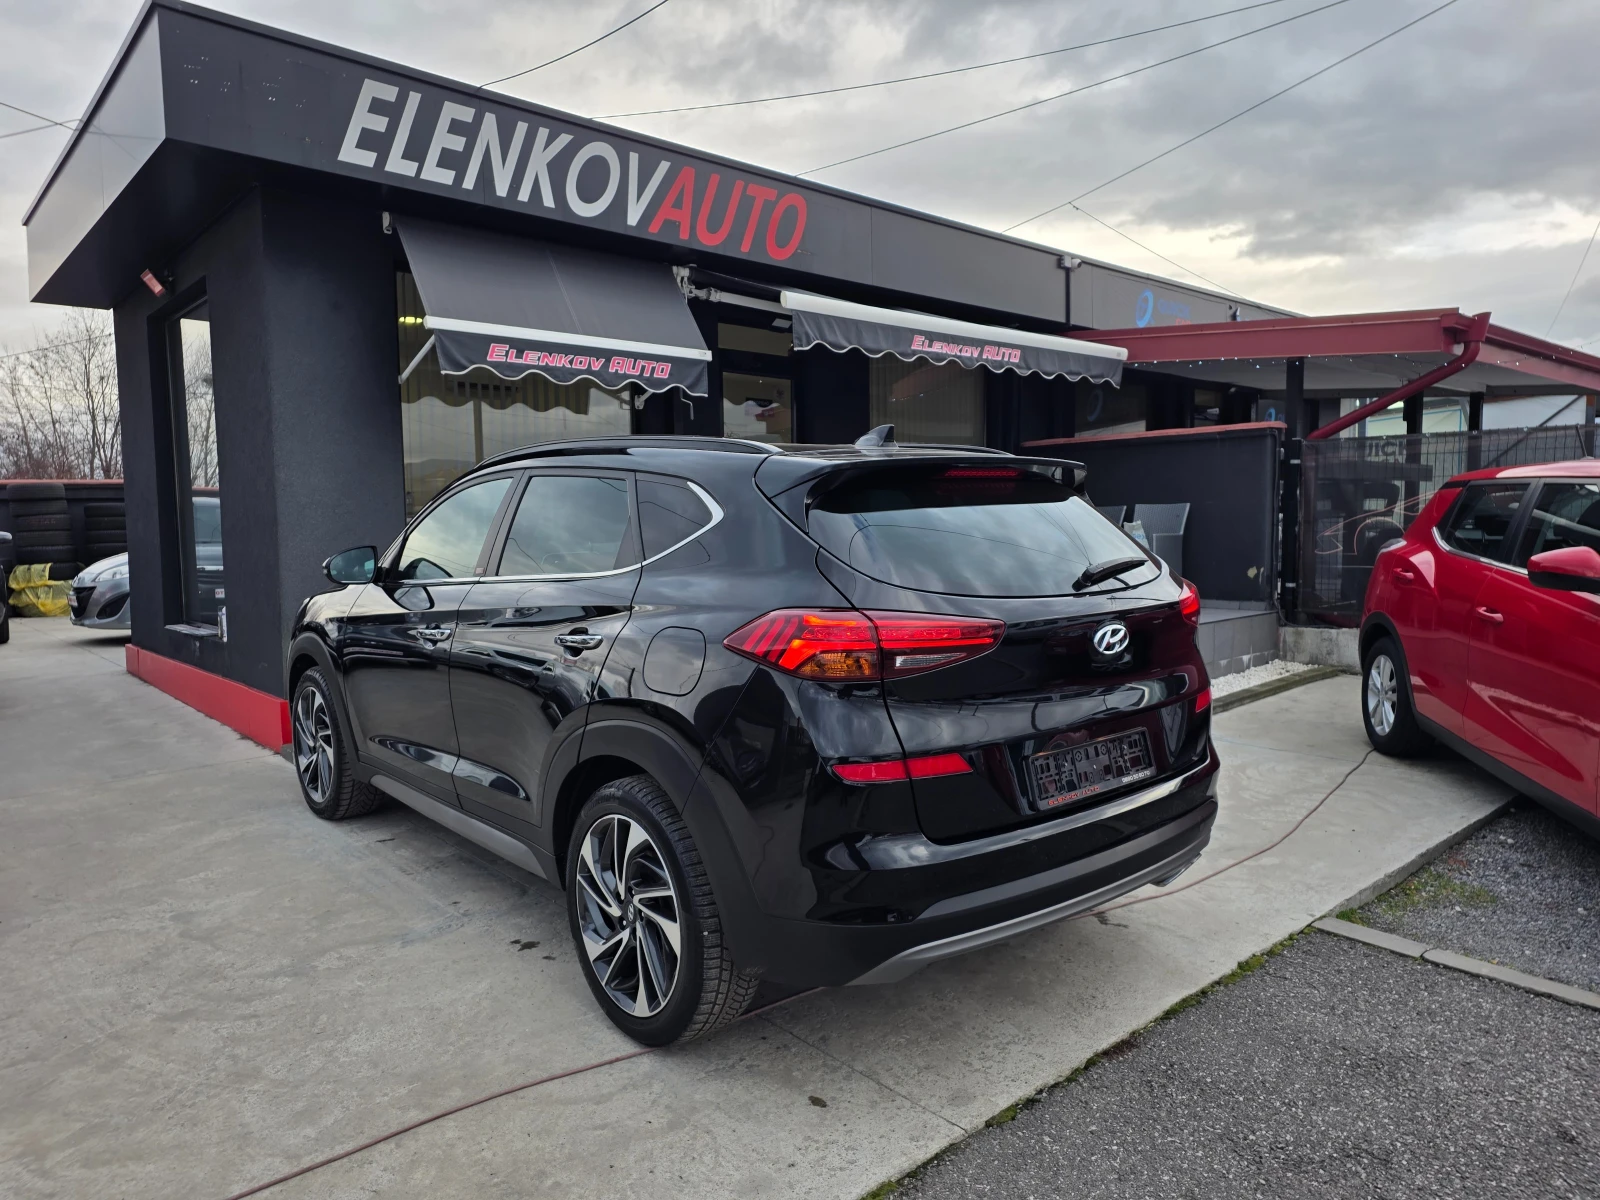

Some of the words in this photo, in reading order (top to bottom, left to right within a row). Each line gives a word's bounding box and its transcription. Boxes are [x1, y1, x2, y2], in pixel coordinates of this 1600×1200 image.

[487, 343, 605, 371] ELENKOV
[608, 356, 671, 379] AUTO
[911, 335, 981, 358] ELENKOV
[982, 345, 1021, 363] AUTO
